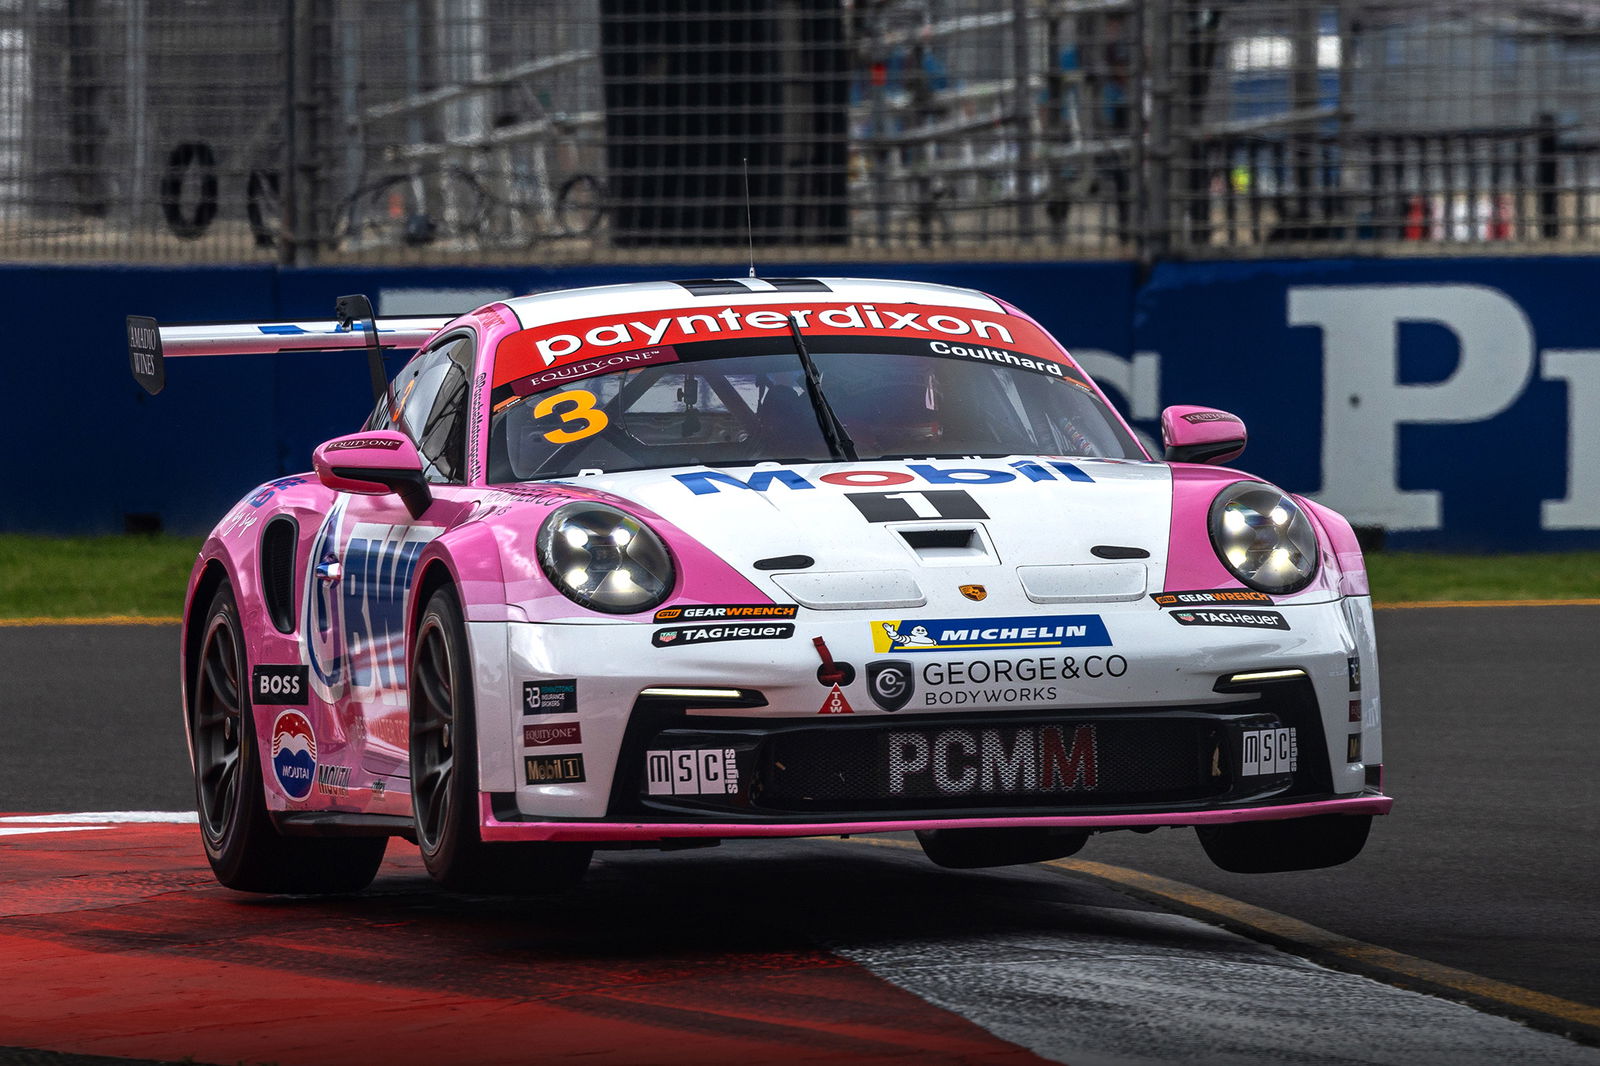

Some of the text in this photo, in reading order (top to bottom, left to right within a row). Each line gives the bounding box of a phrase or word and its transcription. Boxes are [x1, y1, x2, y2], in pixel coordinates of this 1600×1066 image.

[130, 326, 157, 350] AMADIO
[535, 303, 1015, 367] paynterdixon
[133, 353, 155, 375] WINES
[929, 341, 1063, 377] Coulthard
[533, 389, 608, 444] 3
[671, 460, 1096, 496] Mobil
[884, 492, 943, 519] 1
[1178, 592, 1269, 602] GEARWRENCH
[684, 607, 796, 618] GEARWRENCH
[941, 625, 1087, 642] MICHELIN
[923, 654, 1128, 686] GEORGE&CO
[260, 675, 300, 694] BOSS
[829, 691, 843, 713] TOW
[925, 687, 1057, 706] BODYWORKS
[527, 759, 563, 780] Mobil
[888, 723, 1099, 794] PCMM
[282, 765, 310, 780] MOUTAI
[725, 749, 739, 794] signs
